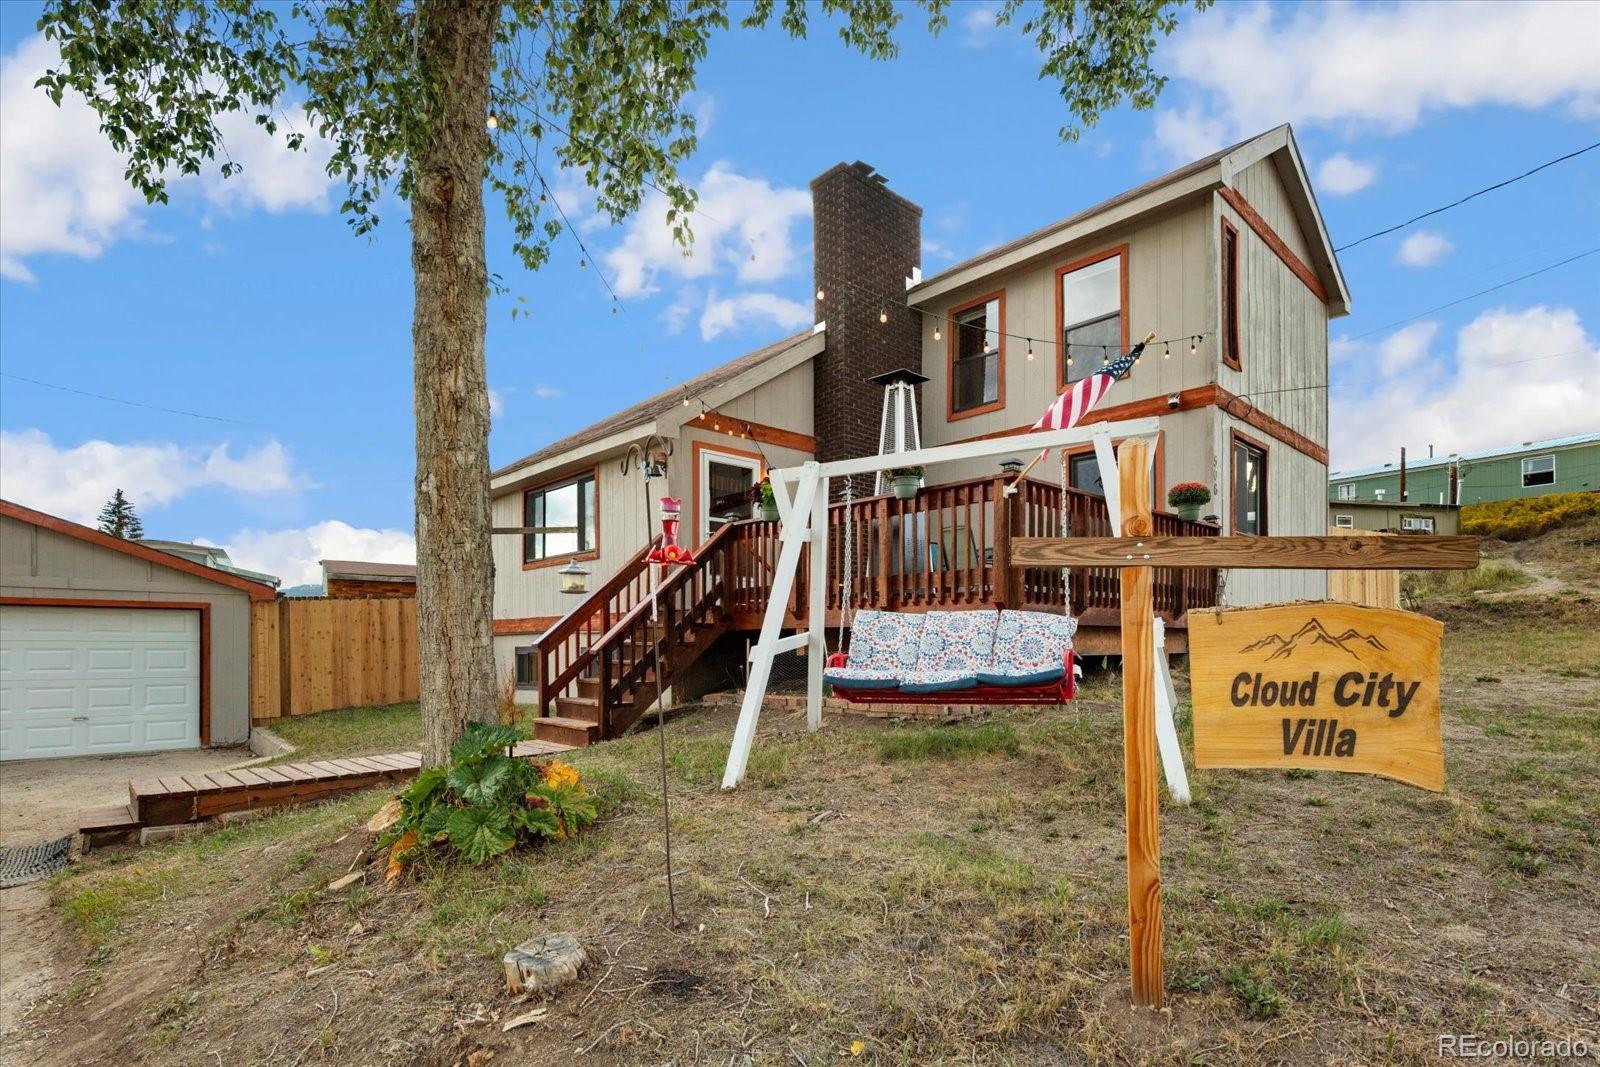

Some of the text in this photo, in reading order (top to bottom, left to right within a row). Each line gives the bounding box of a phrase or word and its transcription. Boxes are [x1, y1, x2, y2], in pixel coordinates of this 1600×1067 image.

[1230, 671, 1421, 718] Cloud City
[1282, 718, 1357, 758] Villa
